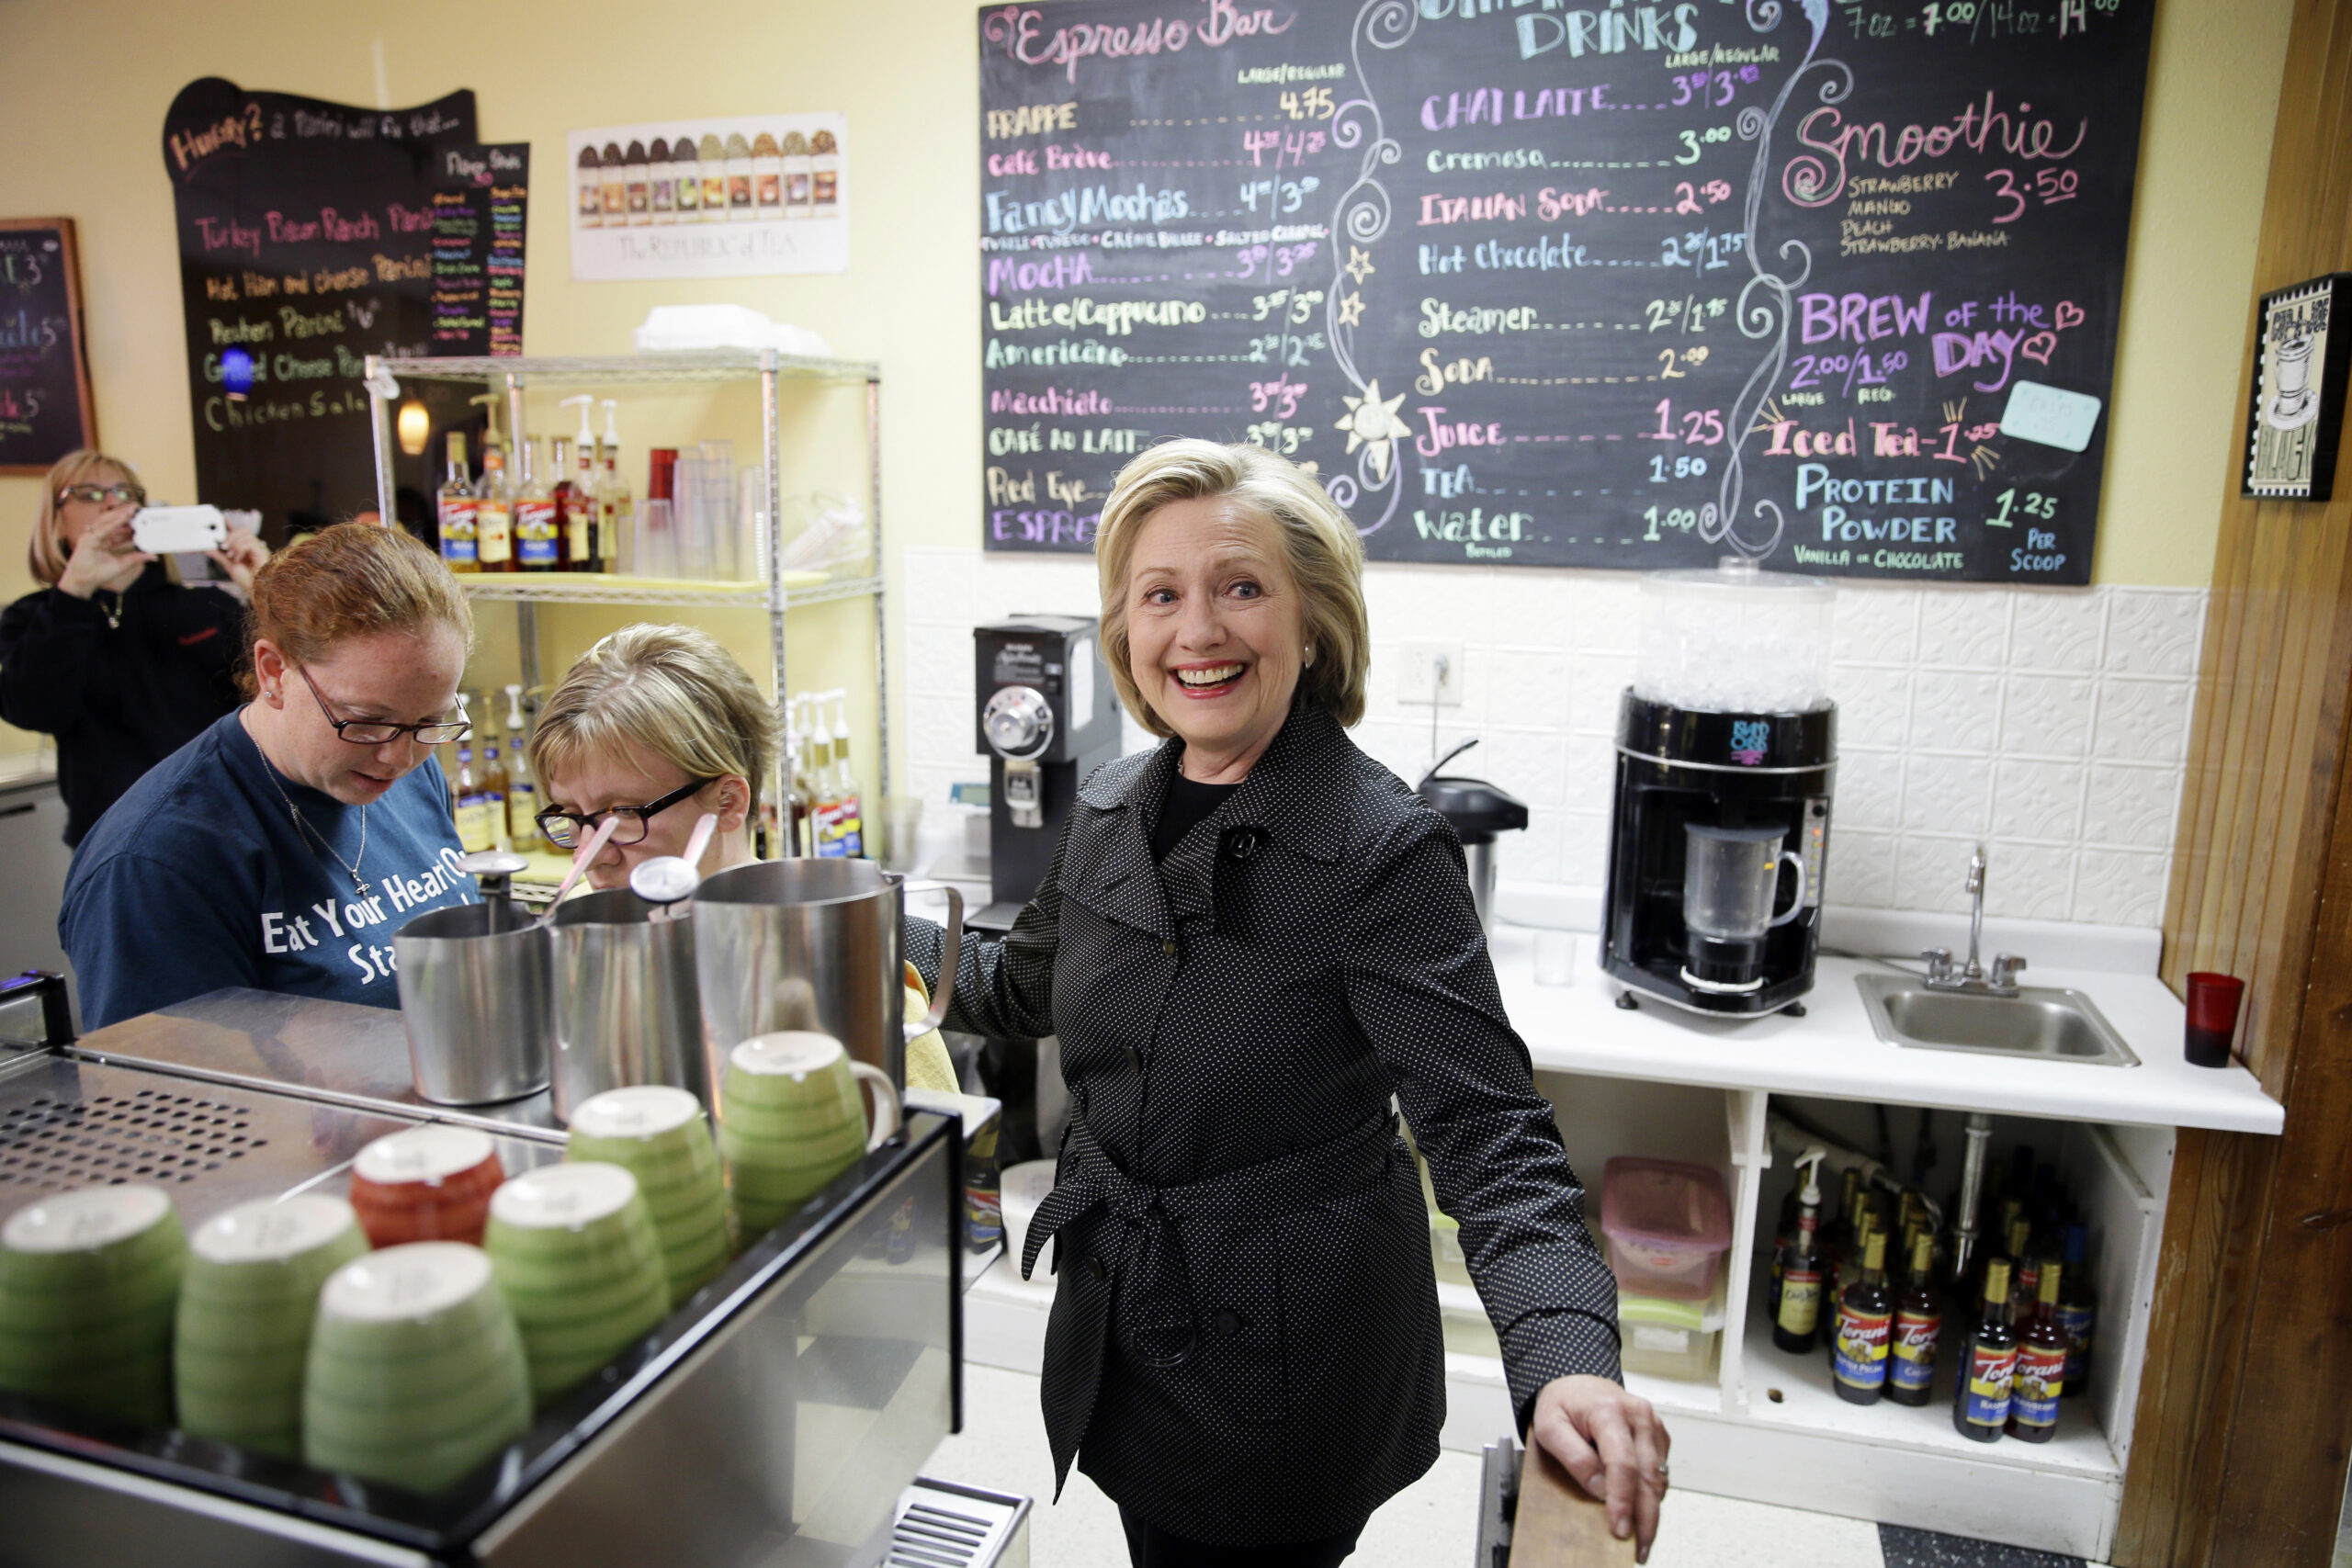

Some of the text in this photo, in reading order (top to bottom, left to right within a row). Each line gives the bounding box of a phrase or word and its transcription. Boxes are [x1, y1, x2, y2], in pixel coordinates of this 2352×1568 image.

[1015, 0, 1296, 84] Espresso Bar
[1515, 3, 1699, 61] DRINKS
[987, 102, 1078, 139] FRAPPE
[1420, 88, 1503, 130] CHAI
[1427, 148, 1549, 174] Cremosa
[1782, 90, 2087, 207] Smoothie
[1848, 171, 1960, 198] STRAWBERRY
[1984, 168, 2079, 223] 3.50
[1417, 192, 1527, 226] ITALIAN
[1840, 220, 1894, 238] PEACH
[1418, 242, 1467, 275] Hot
[1475, 232, 1592, 272] Chocolate
[1418, 297, 1538, 338] Steamer
[1797, 289, 1933, 344] BREW
[1988, 289, 2052, 329] the
[1932, 327, 2026, 392] DAY
[1781, 390, 1826, 407] LARGE
[1652, 399, 1724, 446] 1.25
[1763, 416, 1857, 457] Iced
[987, 466, 1037, 507] Red
[1796, 463, 1954, 511] PROTEIN
[992, 509, 1103, 544] ESPRE
[1413, 505, 1697, 542] Water 1.00
[1822, 505, 1957, 544] POWDER
[1985, 488, 2059, 529] 1.25
[1793, 545, 1850, 566] VANILLA
[1873, 548, 1965, 570] CHOCOLATE
[2028, 527, 2057, 550] PER
[2010, 548, 2067, 571] SCOOP
[261, 912, 320, 954] Eat
[311, 898, 388, 938] Your
